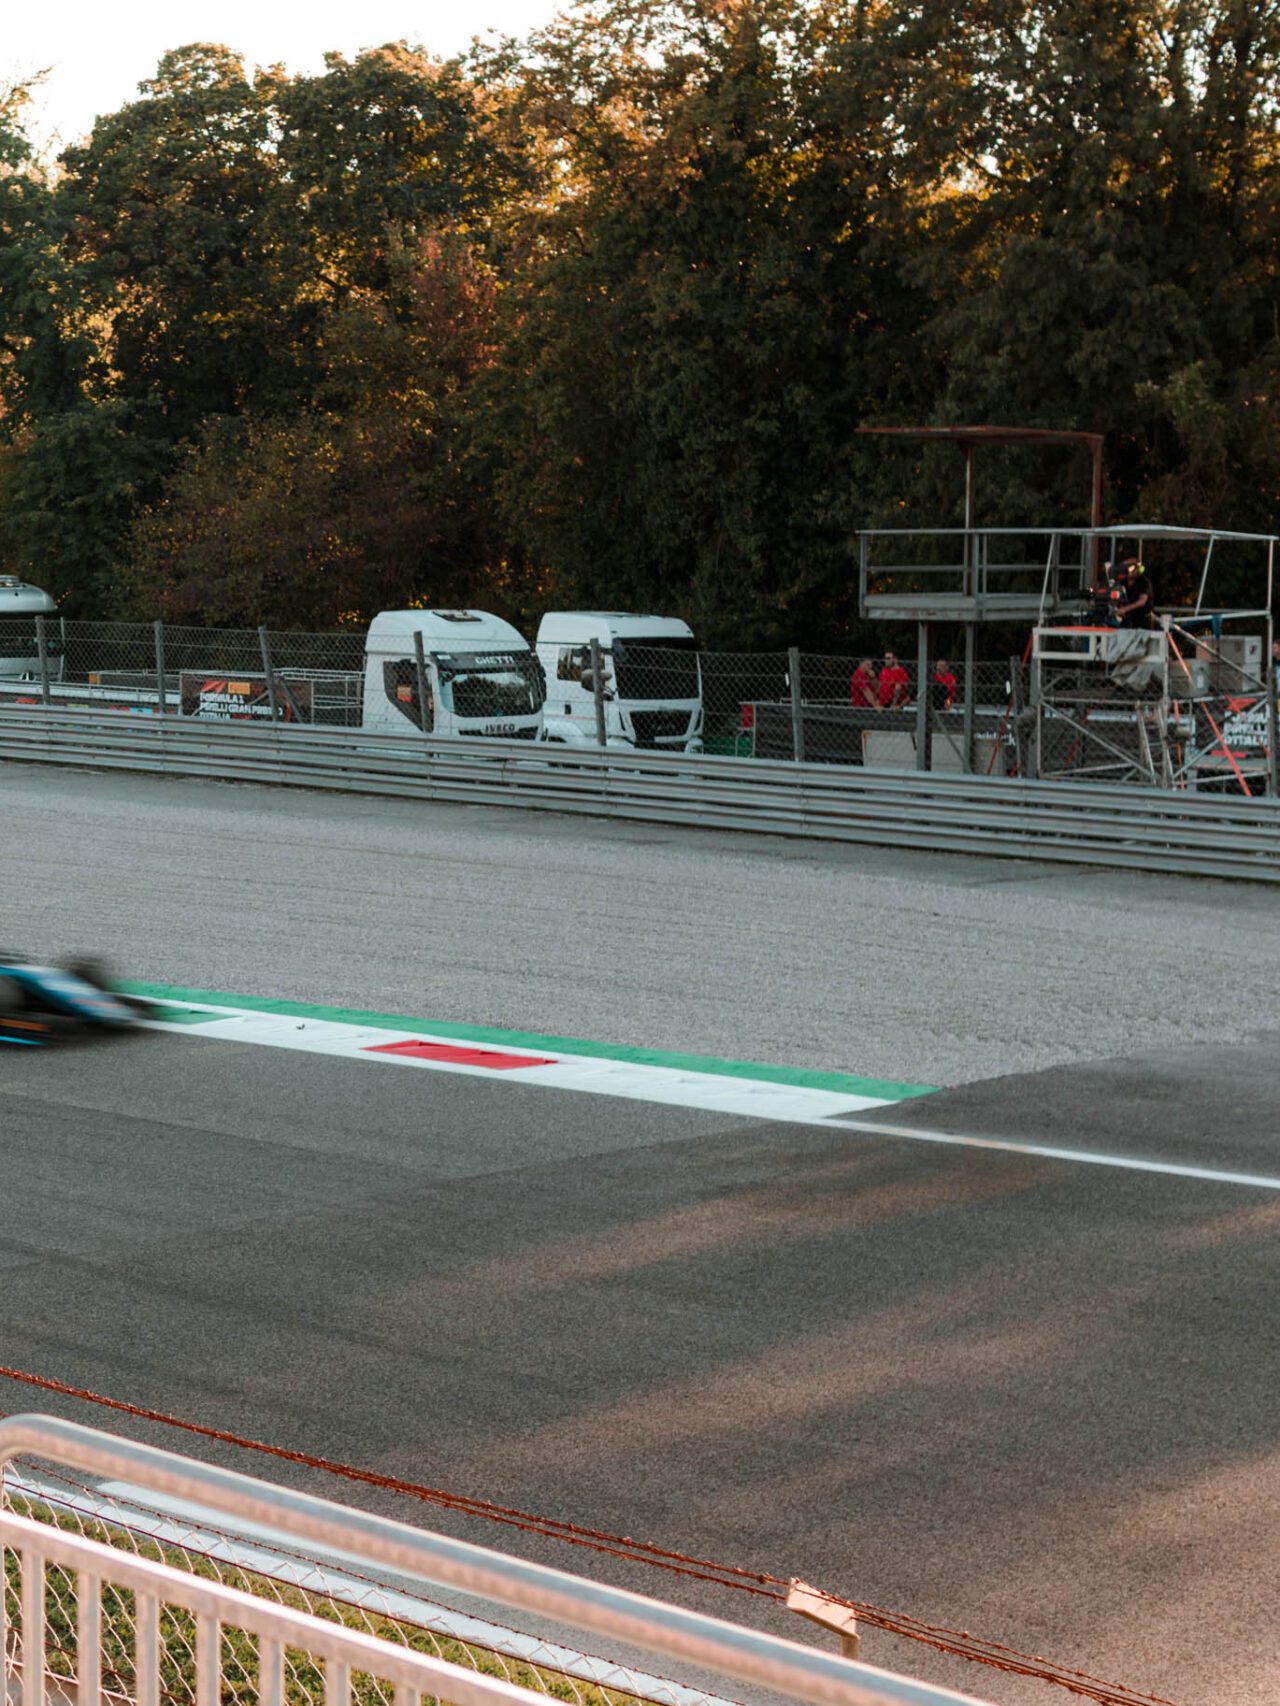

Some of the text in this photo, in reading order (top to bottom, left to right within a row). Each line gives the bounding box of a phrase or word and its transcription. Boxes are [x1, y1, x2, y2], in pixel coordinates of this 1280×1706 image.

[228, 704, 251, 713] GRAN
[252, 706, 283, 715] PREMO
[485, 723, 515, 732] IVECO
